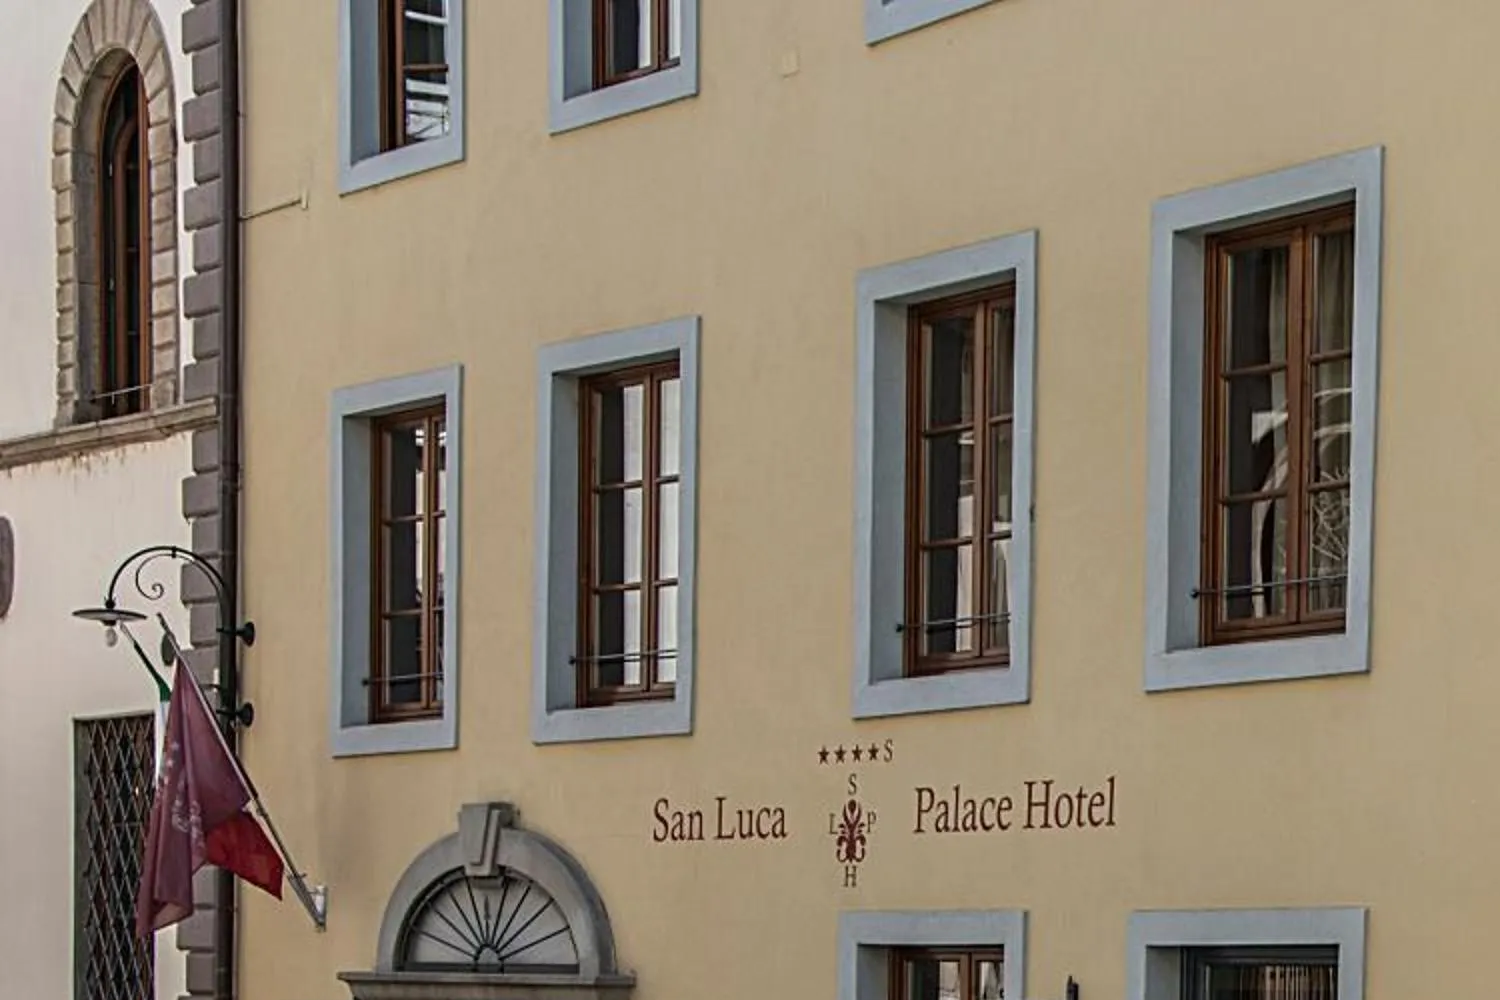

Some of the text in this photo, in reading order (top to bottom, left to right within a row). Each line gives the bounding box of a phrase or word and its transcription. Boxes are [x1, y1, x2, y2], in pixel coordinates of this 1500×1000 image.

[883, 739, 894, 763] S
[847, 773, 858, 796] S
[653, 775, 1116, 842] San Luca Palace Hotel
[828, 811, 877, 835] L P
[843, 865, 858, 888] H
